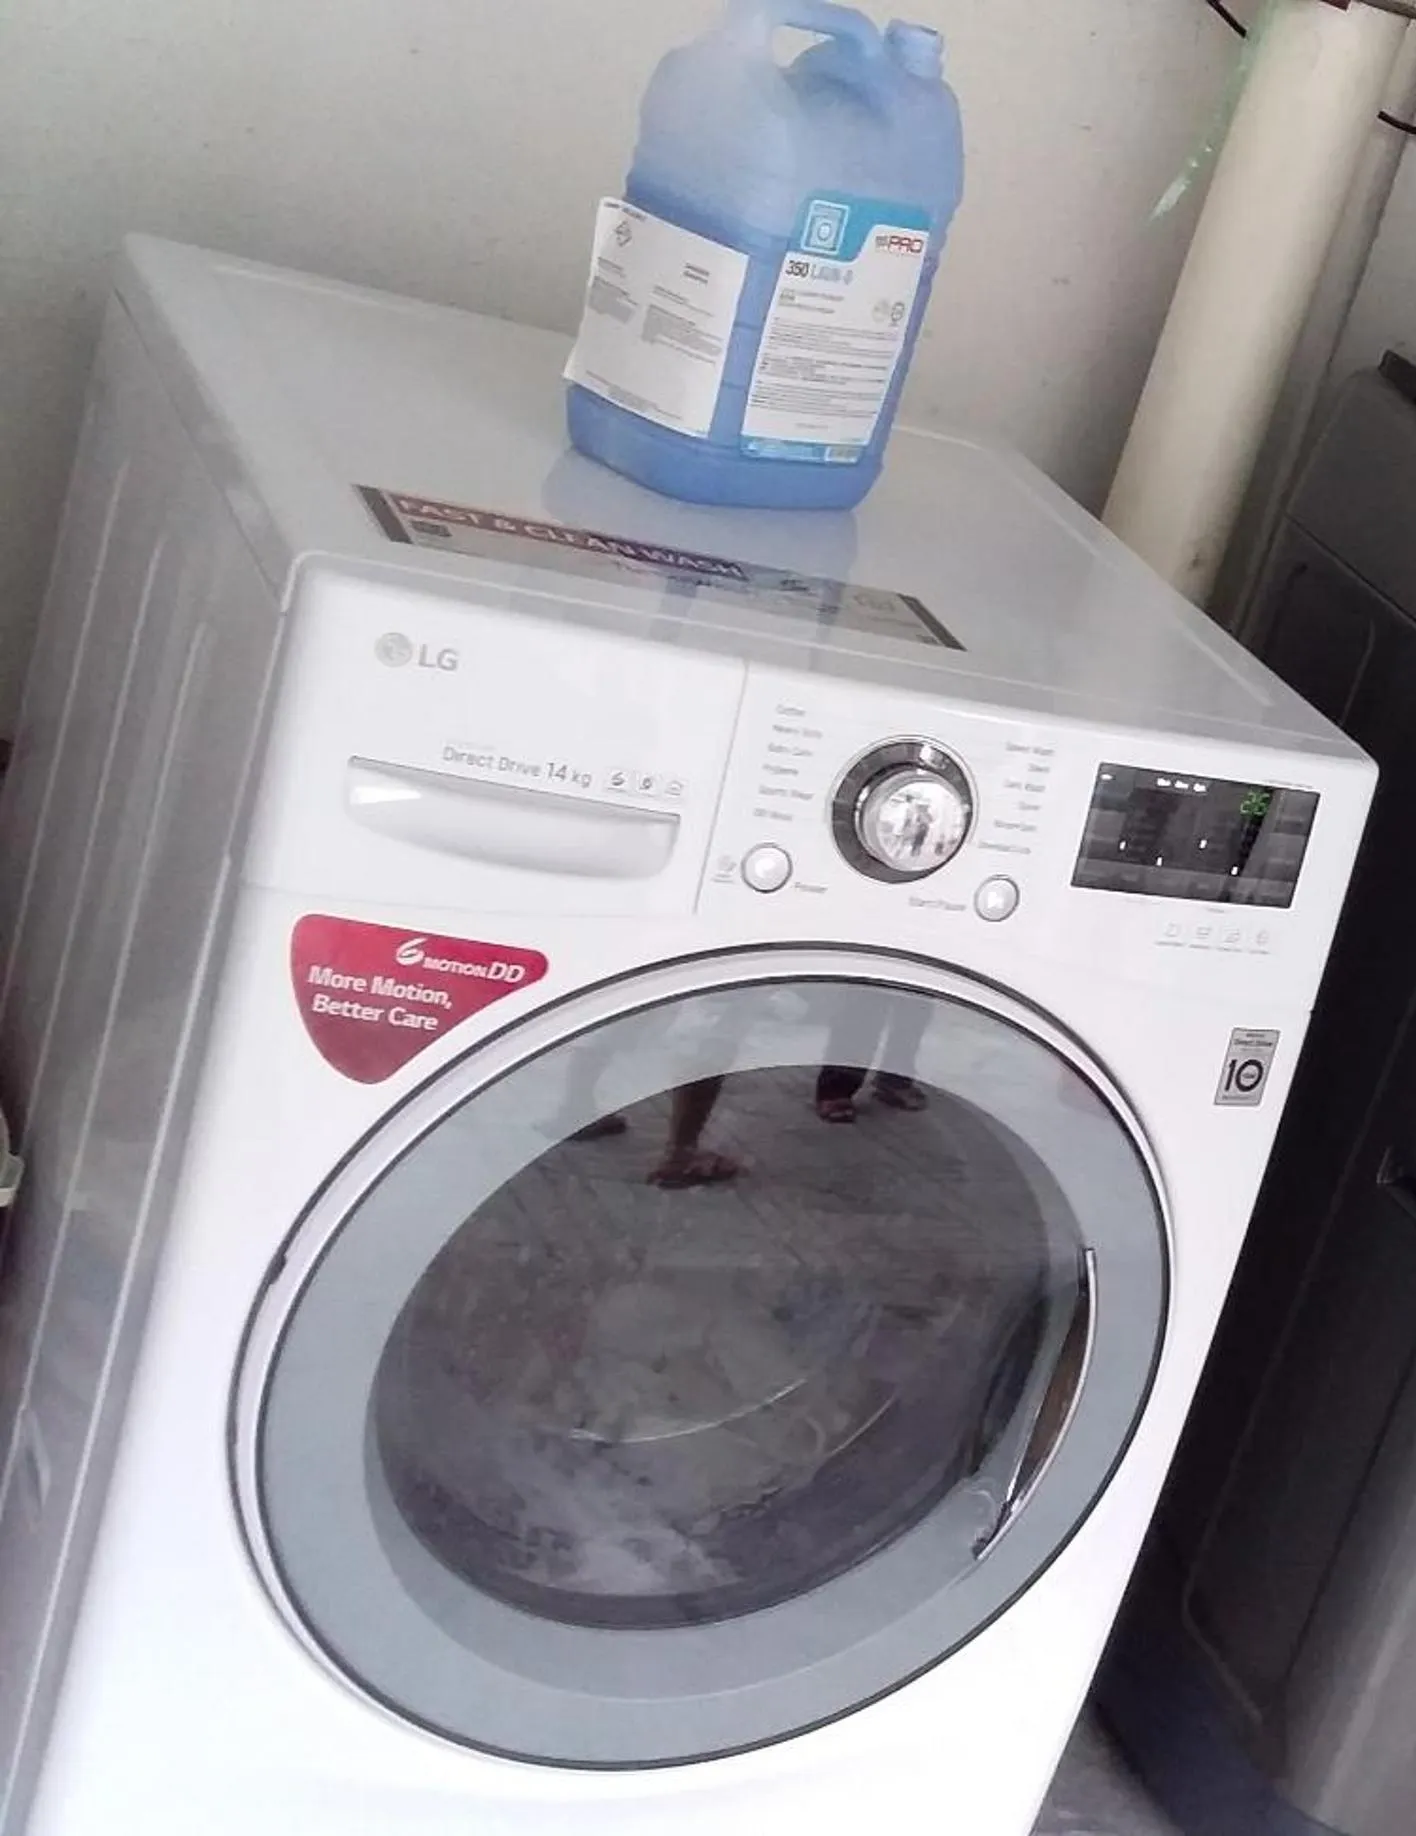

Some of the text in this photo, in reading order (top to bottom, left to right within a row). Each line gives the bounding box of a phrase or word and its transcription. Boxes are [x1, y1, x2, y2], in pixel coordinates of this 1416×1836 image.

[888, 235, 925, 254] PRO
[417, 644, 460, 672] LG
[442, 745, 593, 789] Direct Drive 14 kg
[308, 965, 453, 1009] More Motion,
[312, 993, 439, 1031] Better Care
[1224, 1059, 1264, 1092] 10
